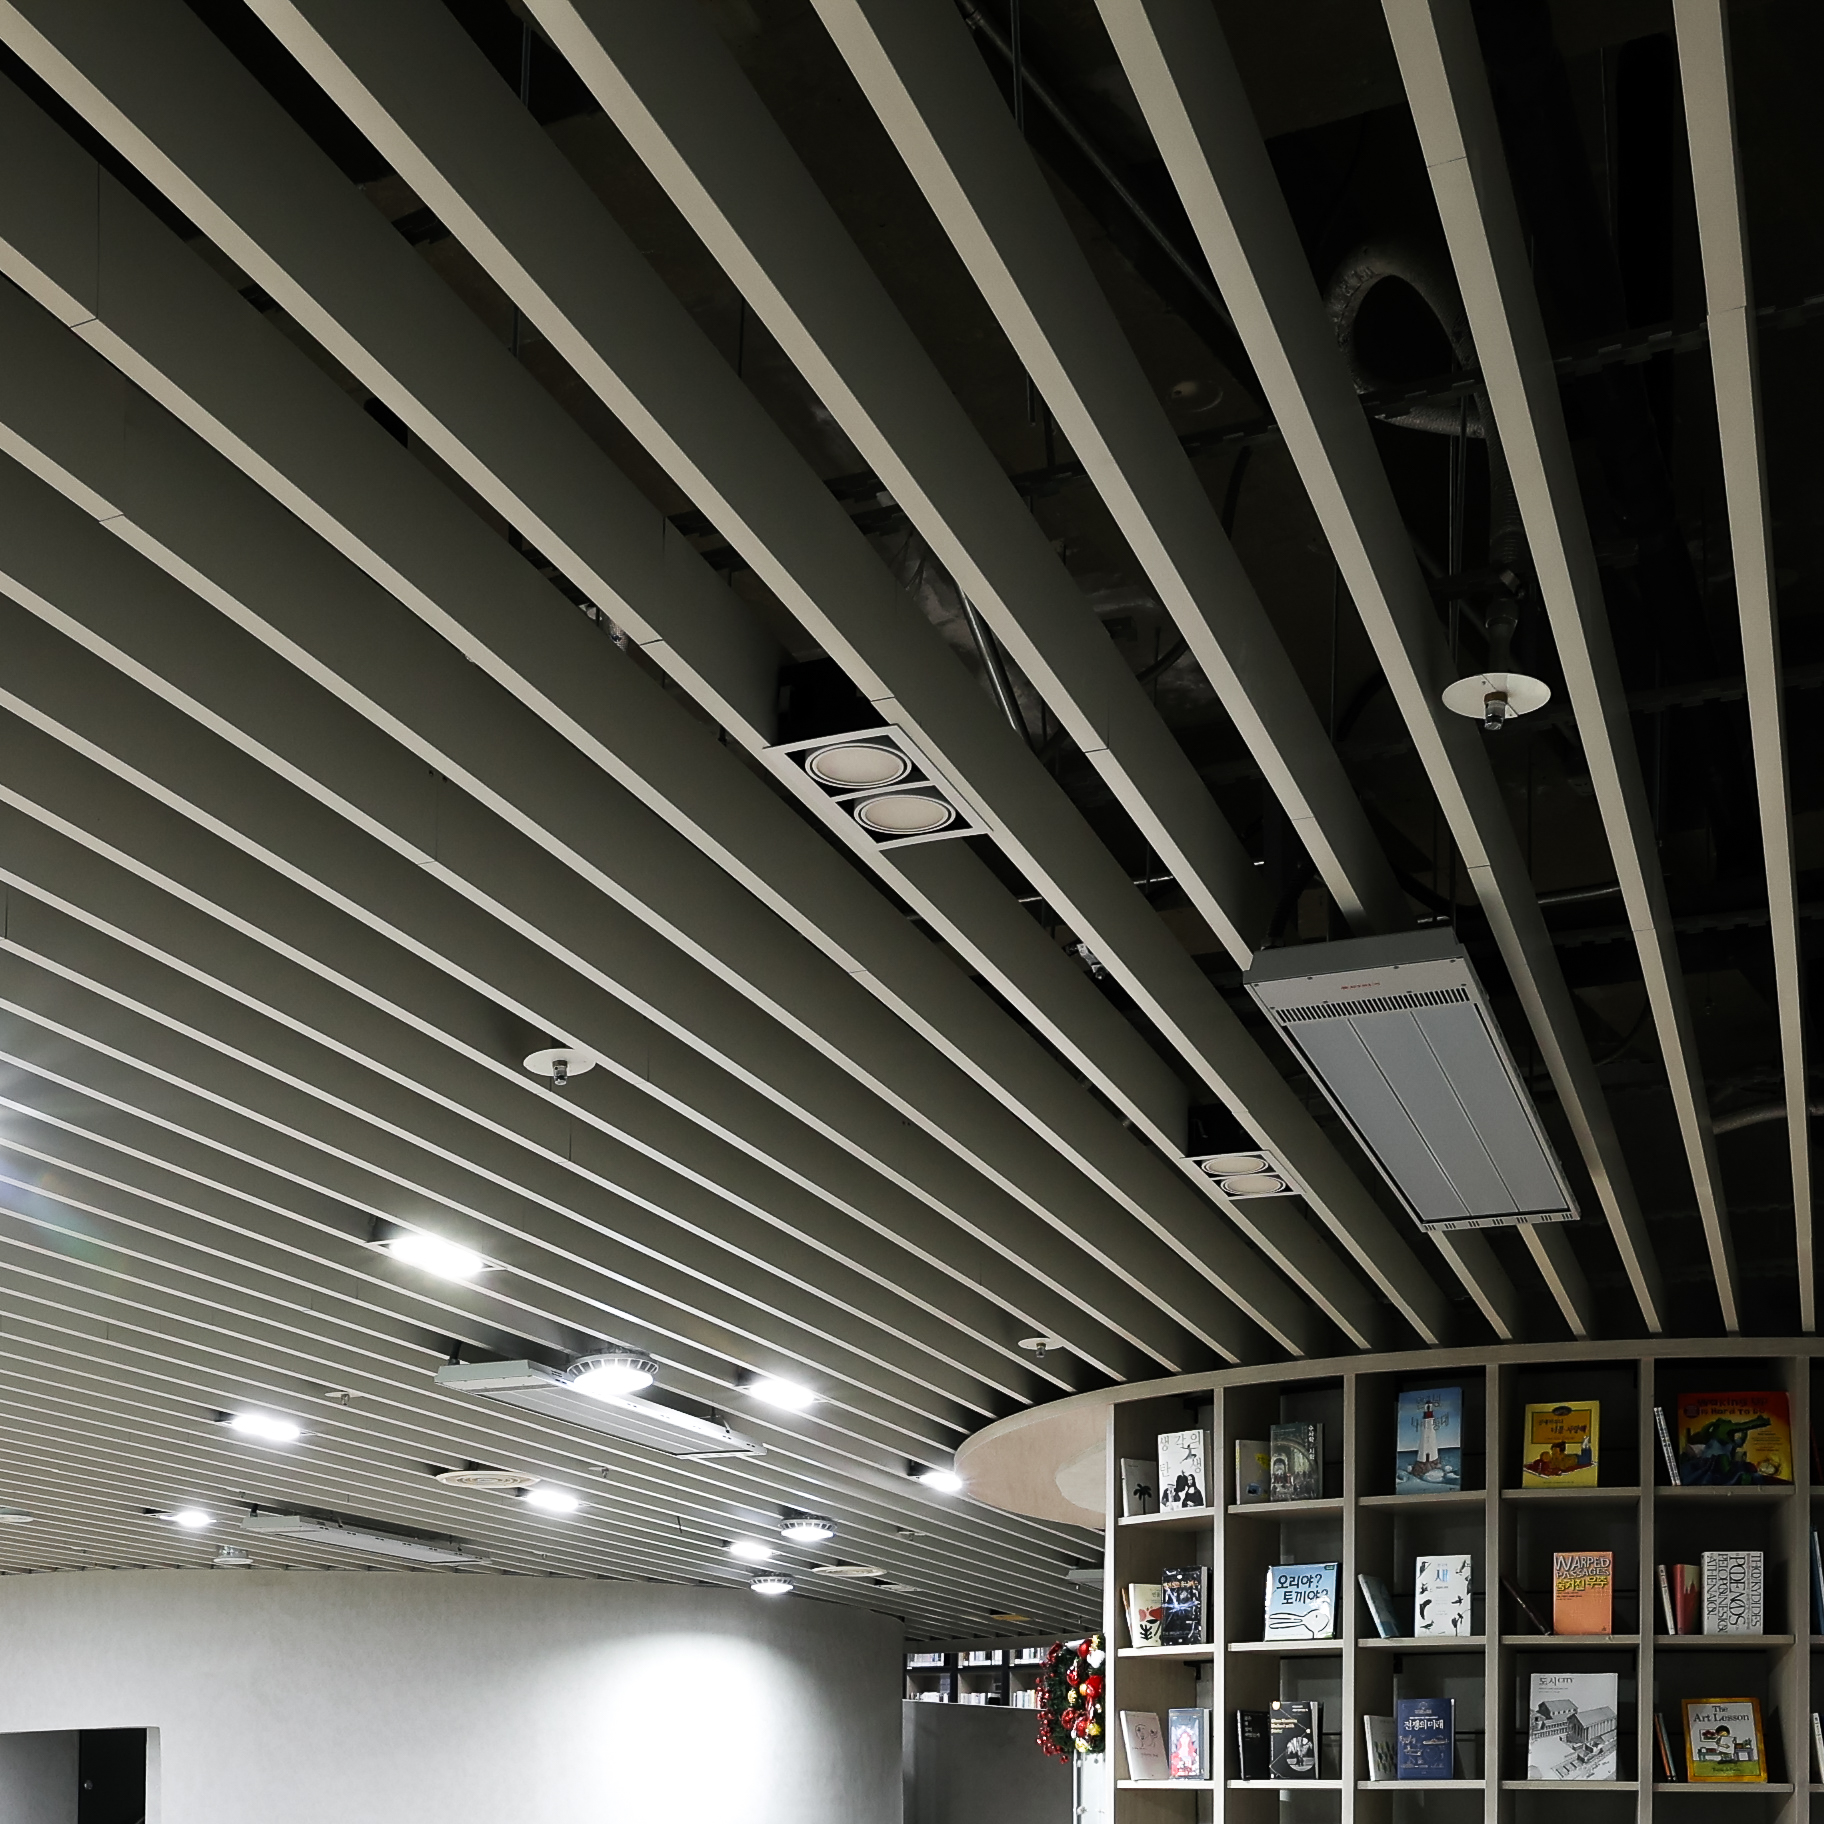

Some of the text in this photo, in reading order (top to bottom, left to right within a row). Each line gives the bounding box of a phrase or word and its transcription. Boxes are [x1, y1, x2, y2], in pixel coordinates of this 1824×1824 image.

[1555, 1556, 1610, 1572] WARPED
[1434, 1569, 1449, 1583] 새
[1556, 1567, 1610, 1579] PASSAGES
[1276, 1573, 1322, 1590] 오리야?
[1556, 1576, 1609, 1592] 숨겨진 우주
[1281, 1589, 1329, 1605] 토끼야?
[1538, 1675, 1556, 1686] 도시
[1711, 1705, 1728, 1713] The
[1693, 1713, 1749, 1723] Art Lesson
[1403, 1719, 1444, 1731] 전쟁의 미래
